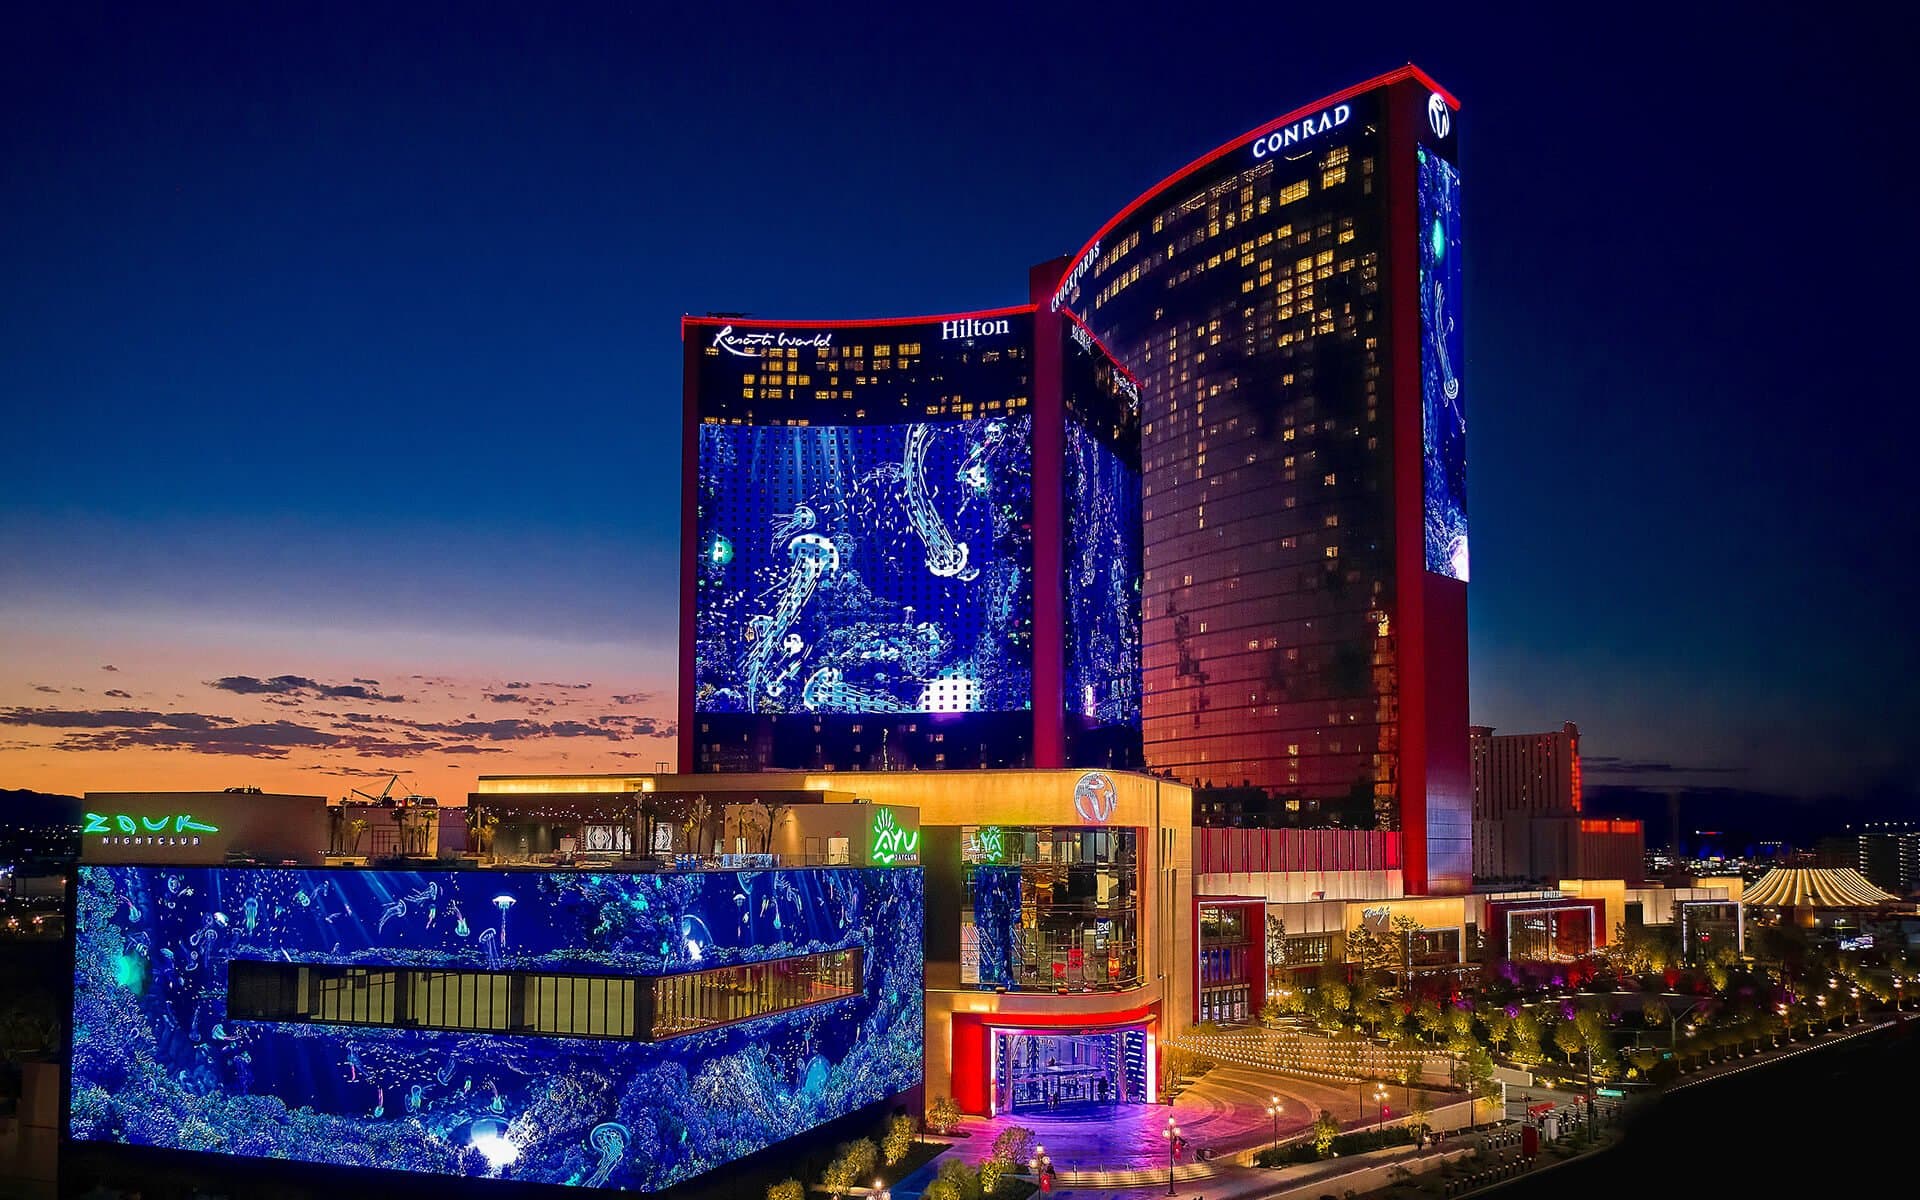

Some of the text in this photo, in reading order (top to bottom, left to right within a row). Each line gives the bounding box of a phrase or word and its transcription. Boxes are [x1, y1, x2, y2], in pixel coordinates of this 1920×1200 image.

[1252, 104, 1350, 158] CONRAD
[1051, 240, 1100, 313] CROCKFORDS
[778, 332, 832, 347] World
[942, 318, 1010, 340] Hilton
[83, 812, 219, 835] ZOUK
[103, 837, 201, 846] NIGHTCLUB
[874, 820, 918, 852] AYU
